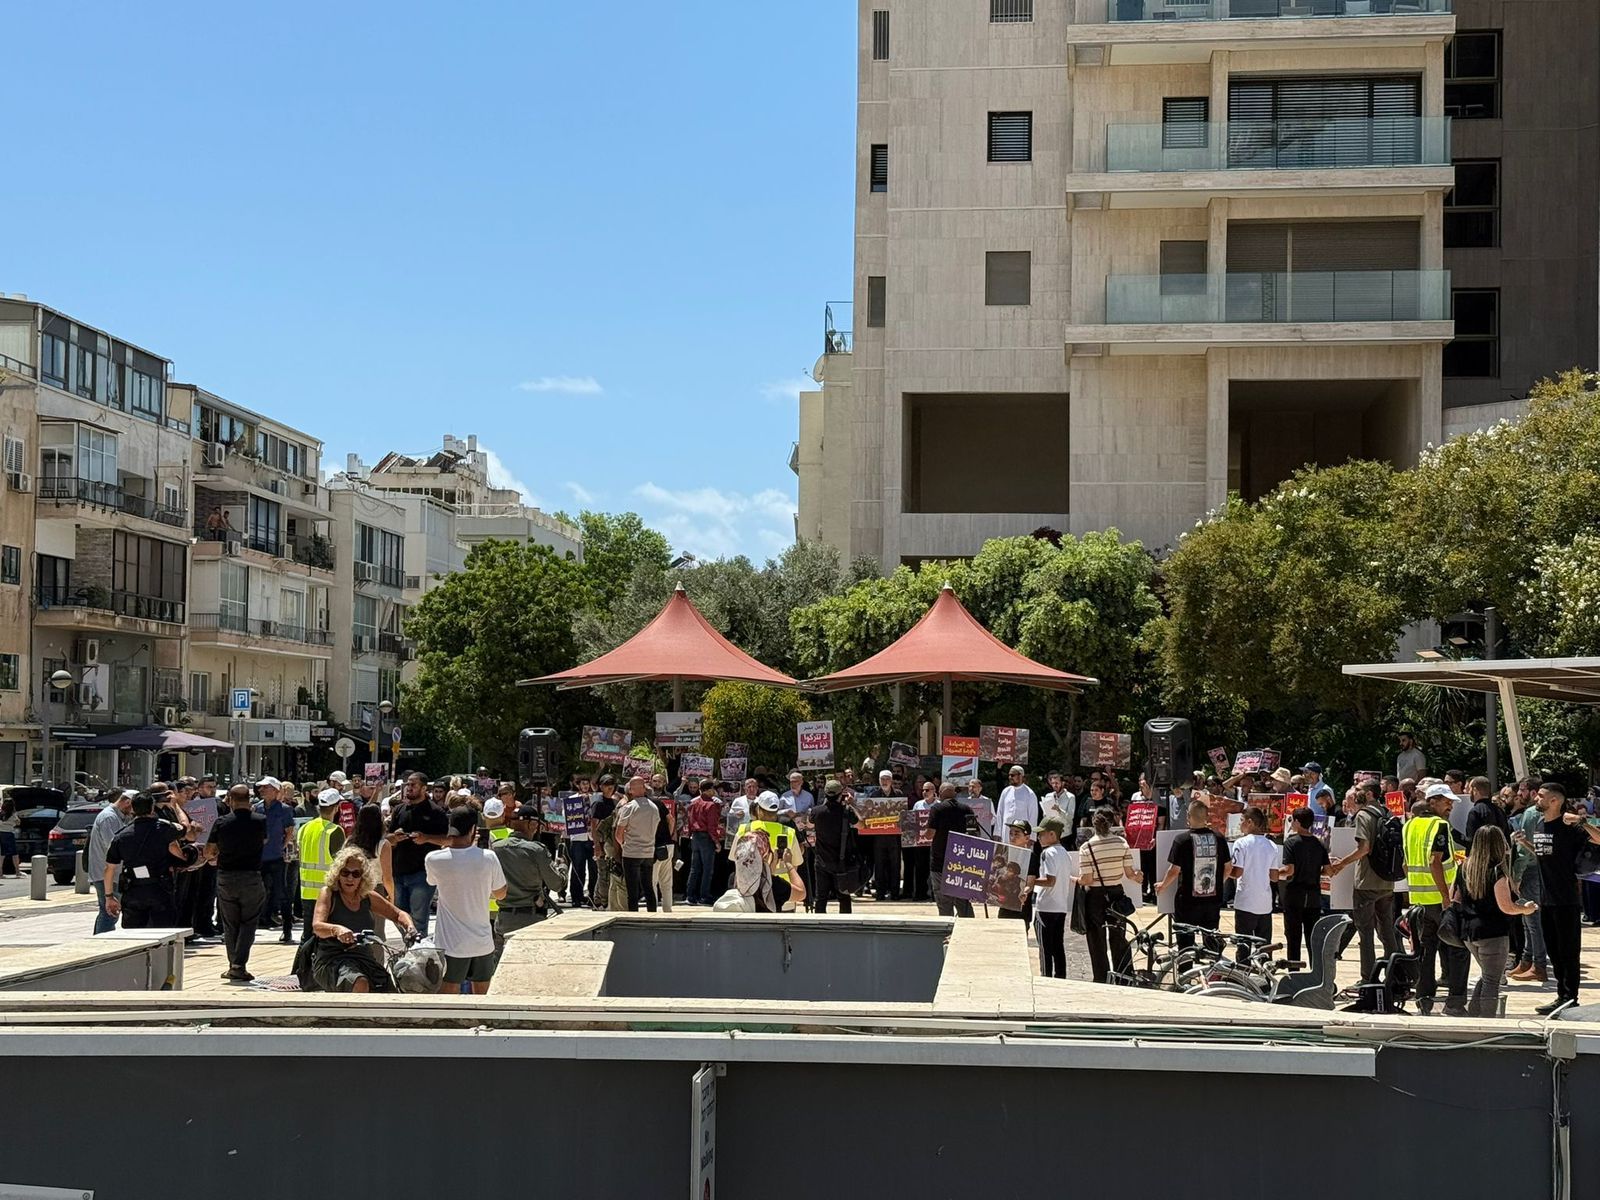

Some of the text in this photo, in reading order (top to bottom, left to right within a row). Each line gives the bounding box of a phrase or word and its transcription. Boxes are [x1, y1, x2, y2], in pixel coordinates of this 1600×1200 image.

[804, 733, 822, 742] تتركوا
[953, 843, 988, 860] اطفال غزة
[947, 861, 986, 879] يستصرخون
[946, 874, 983, 892] علماء الامة
